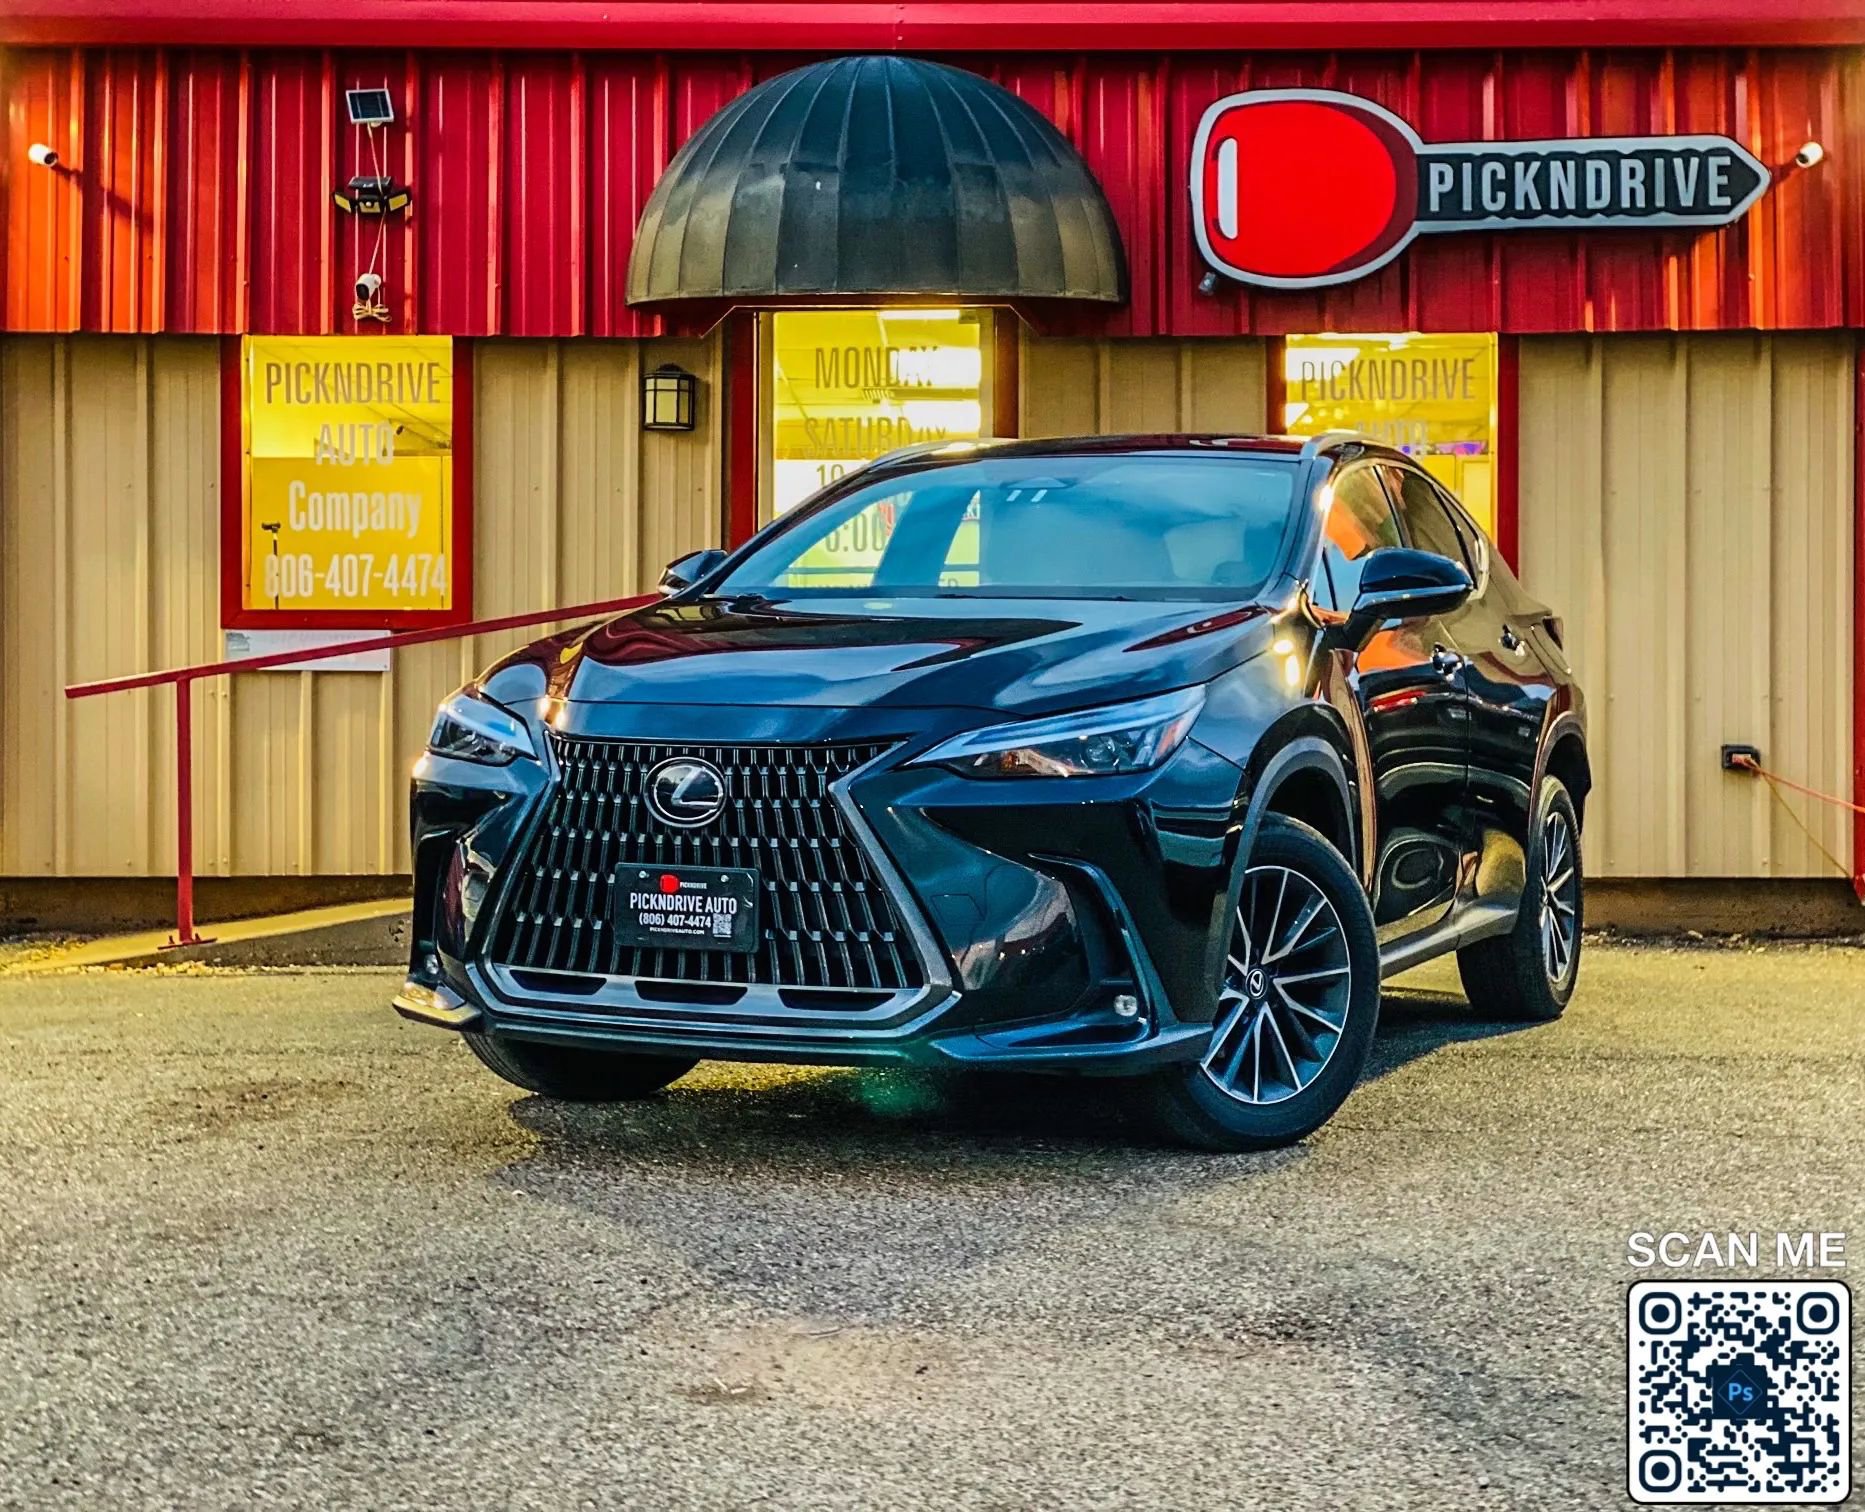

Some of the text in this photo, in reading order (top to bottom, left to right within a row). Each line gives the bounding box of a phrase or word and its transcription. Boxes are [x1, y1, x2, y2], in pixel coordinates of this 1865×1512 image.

[1429, 155, 1732, 212] PICKNDRIVE
[265, 361, 441, 405] PICKNDRIVE
[815, 346, 938, 389] MOND
[1301, 358, 1475, 401] PICKNDRIVE
[315, 422, 394, 466] AUTO
[804, 416, 946, 458] SATURD
[288, 480, 422, 539] Company
[264, 553, 447, 598] 806-407-4474
[629, 892, 738, 915] PICKNDRIVE AUTO
[639, 912, 712, 928] (806) 407-4474
